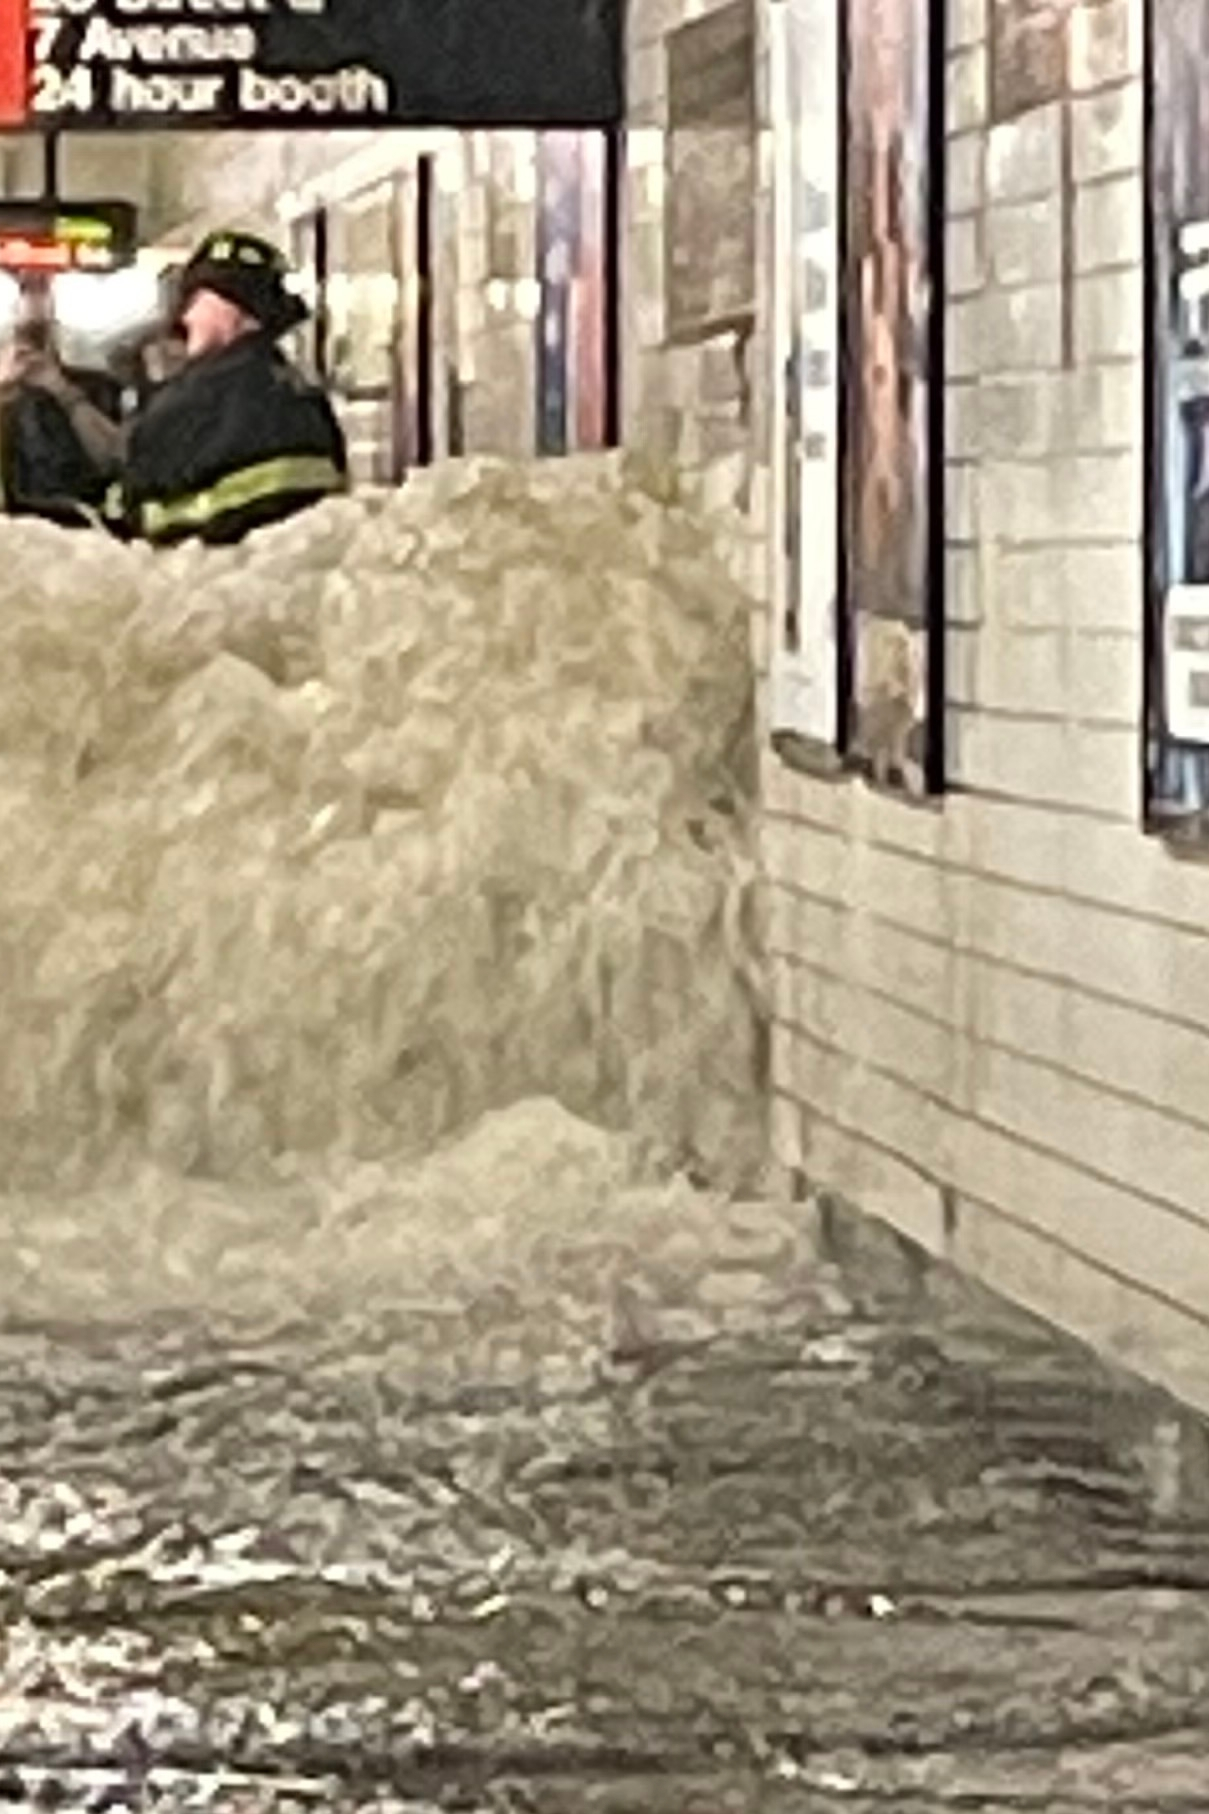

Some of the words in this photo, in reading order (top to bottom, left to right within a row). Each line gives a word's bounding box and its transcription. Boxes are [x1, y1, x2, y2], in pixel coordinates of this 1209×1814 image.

[30, 17, 61, 60] 7
[79, 17, 255, 60] Avenue
[32, 64, 91, 111] 24
[111, 66, 224, 111] hour
[239, 66, 389, 111] booth
